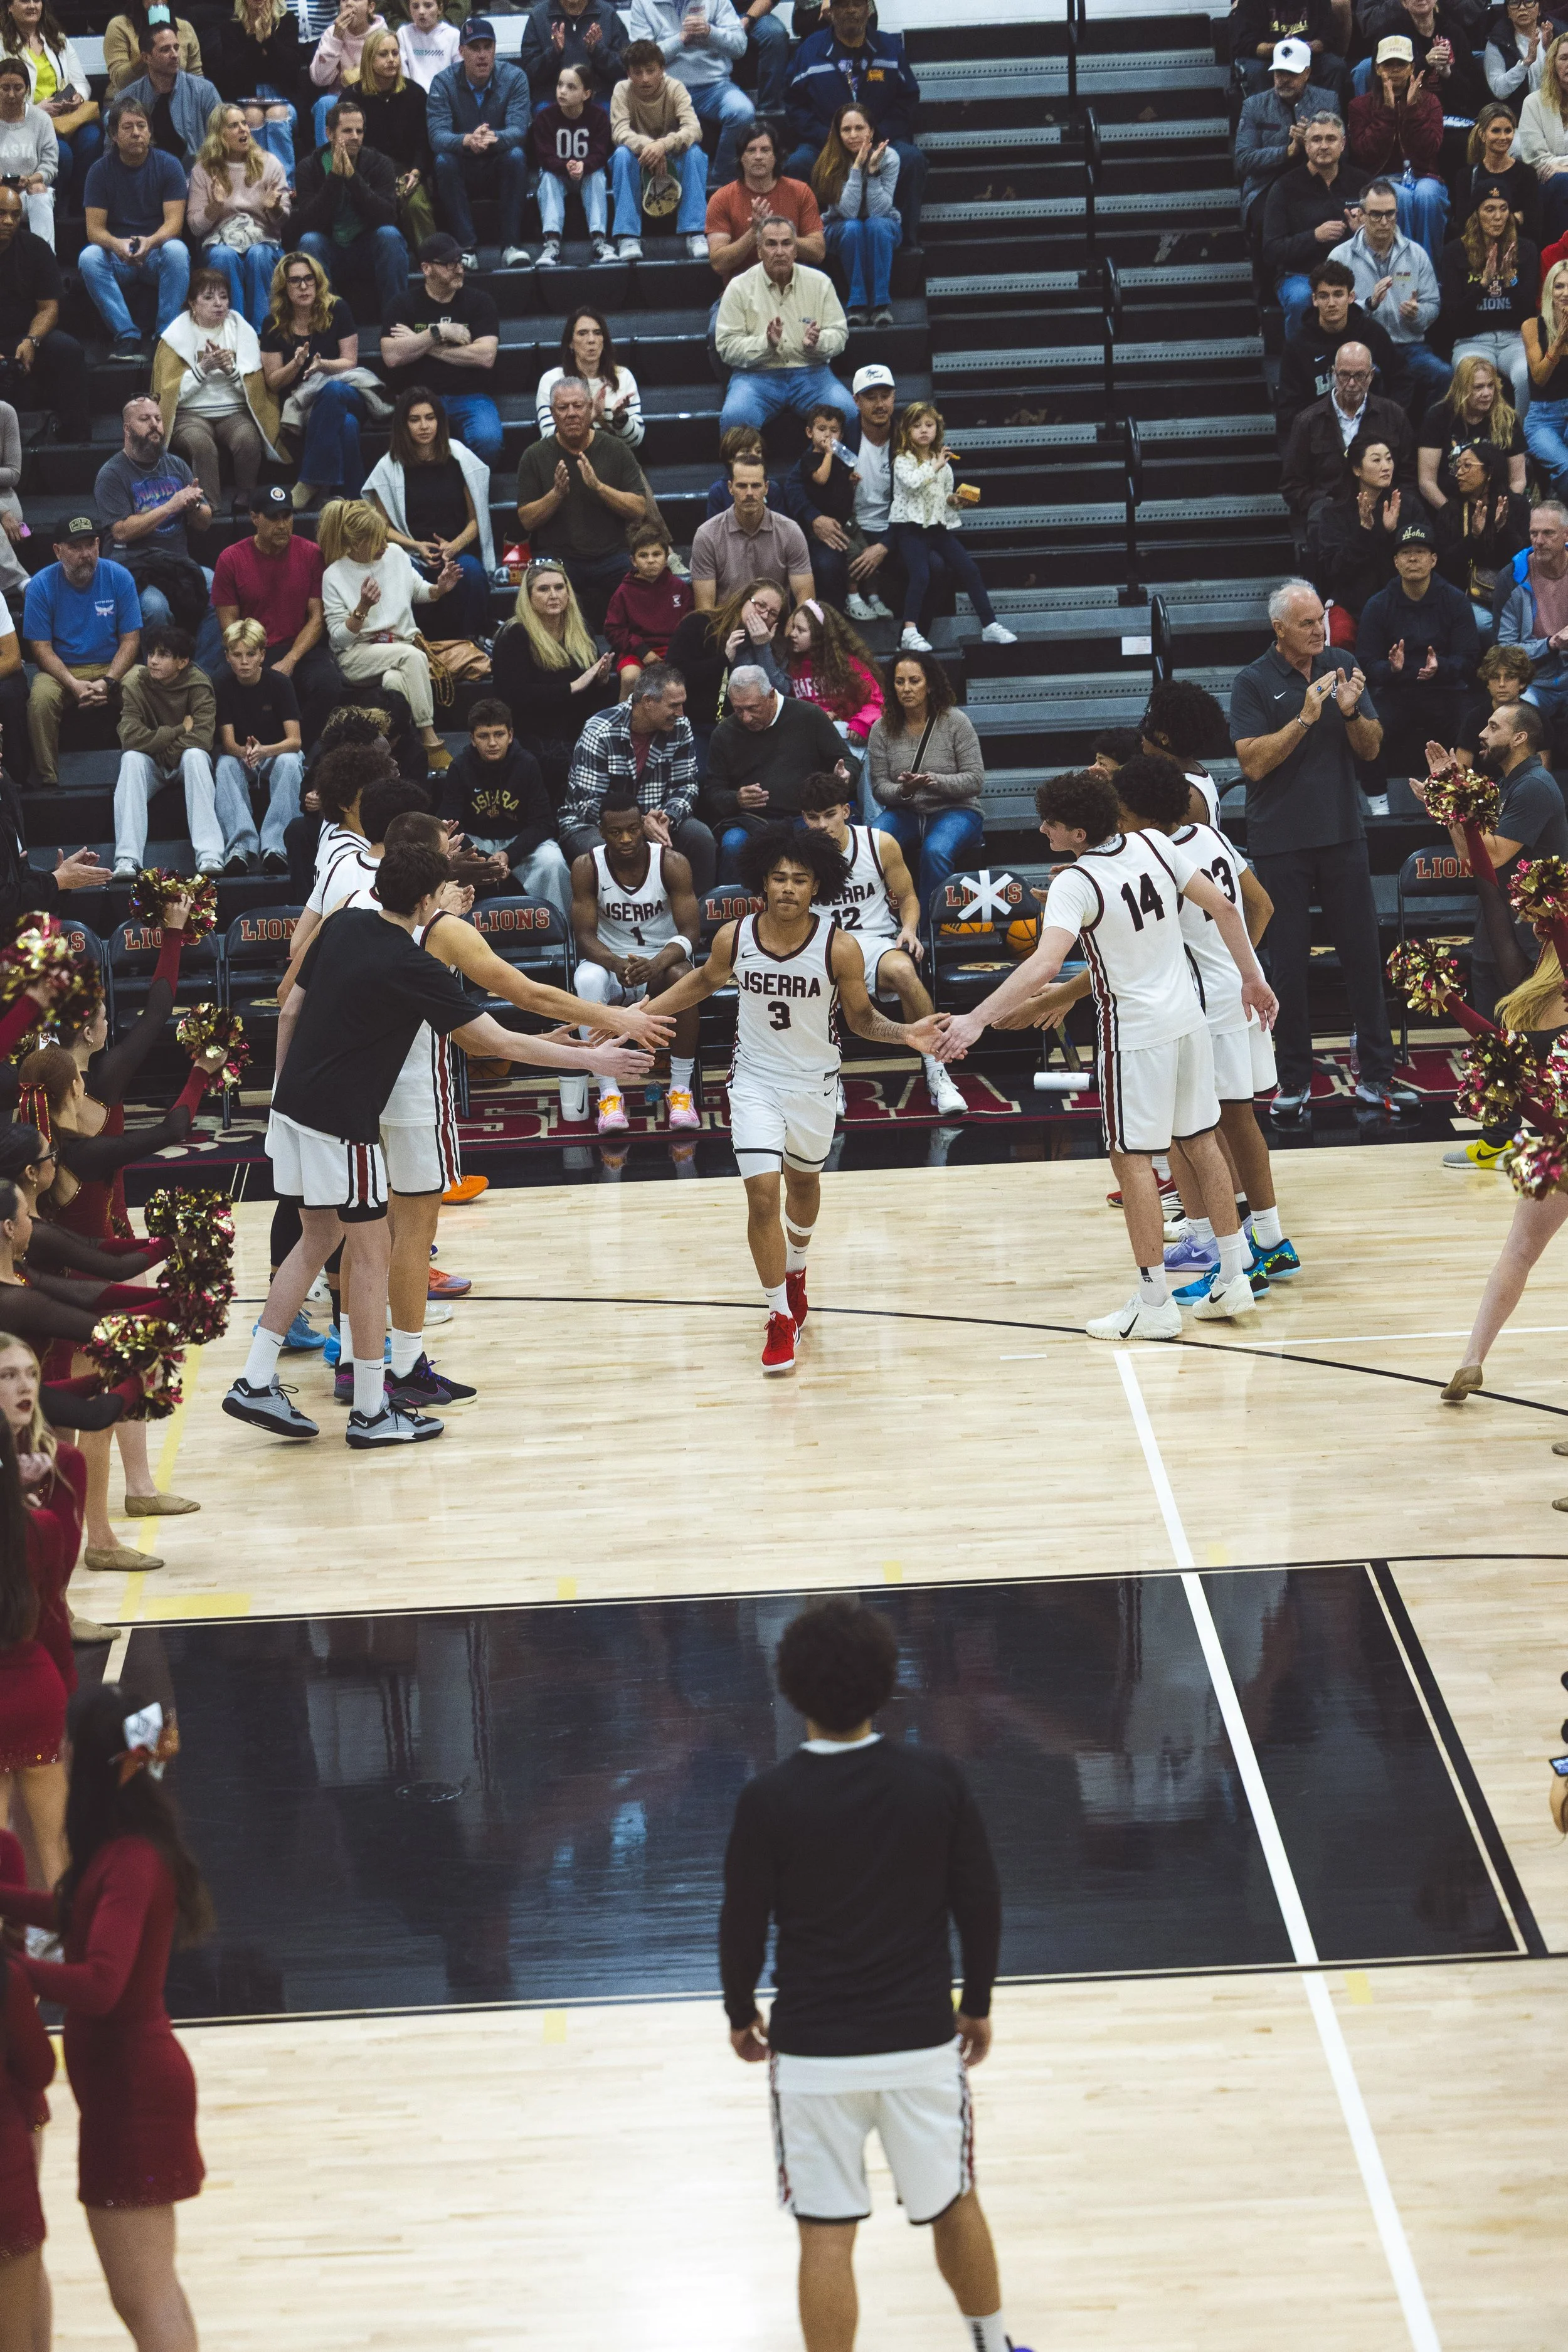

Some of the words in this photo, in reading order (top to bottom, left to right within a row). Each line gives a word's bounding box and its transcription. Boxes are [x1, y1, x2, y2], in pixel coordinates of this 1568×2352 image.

[556, 127, 590, 159] 06
[1416, 857, 1474, 879] LION
[945, 882, 1023, 907] LIS
[1120, 872, 1165, 932] 14
[472, 907, 550, 932] LIONS
[603, 900, 664, 922] JSERRA
[706, 897, 766, 920] LION
[830, 906, 863, 931] 12
[240, 918, 300, 941] LION
[630, 926, 645, 946] 1
[739, 970, 821, 998] JSERRA
[767, 1000, 792, 1031] 3
